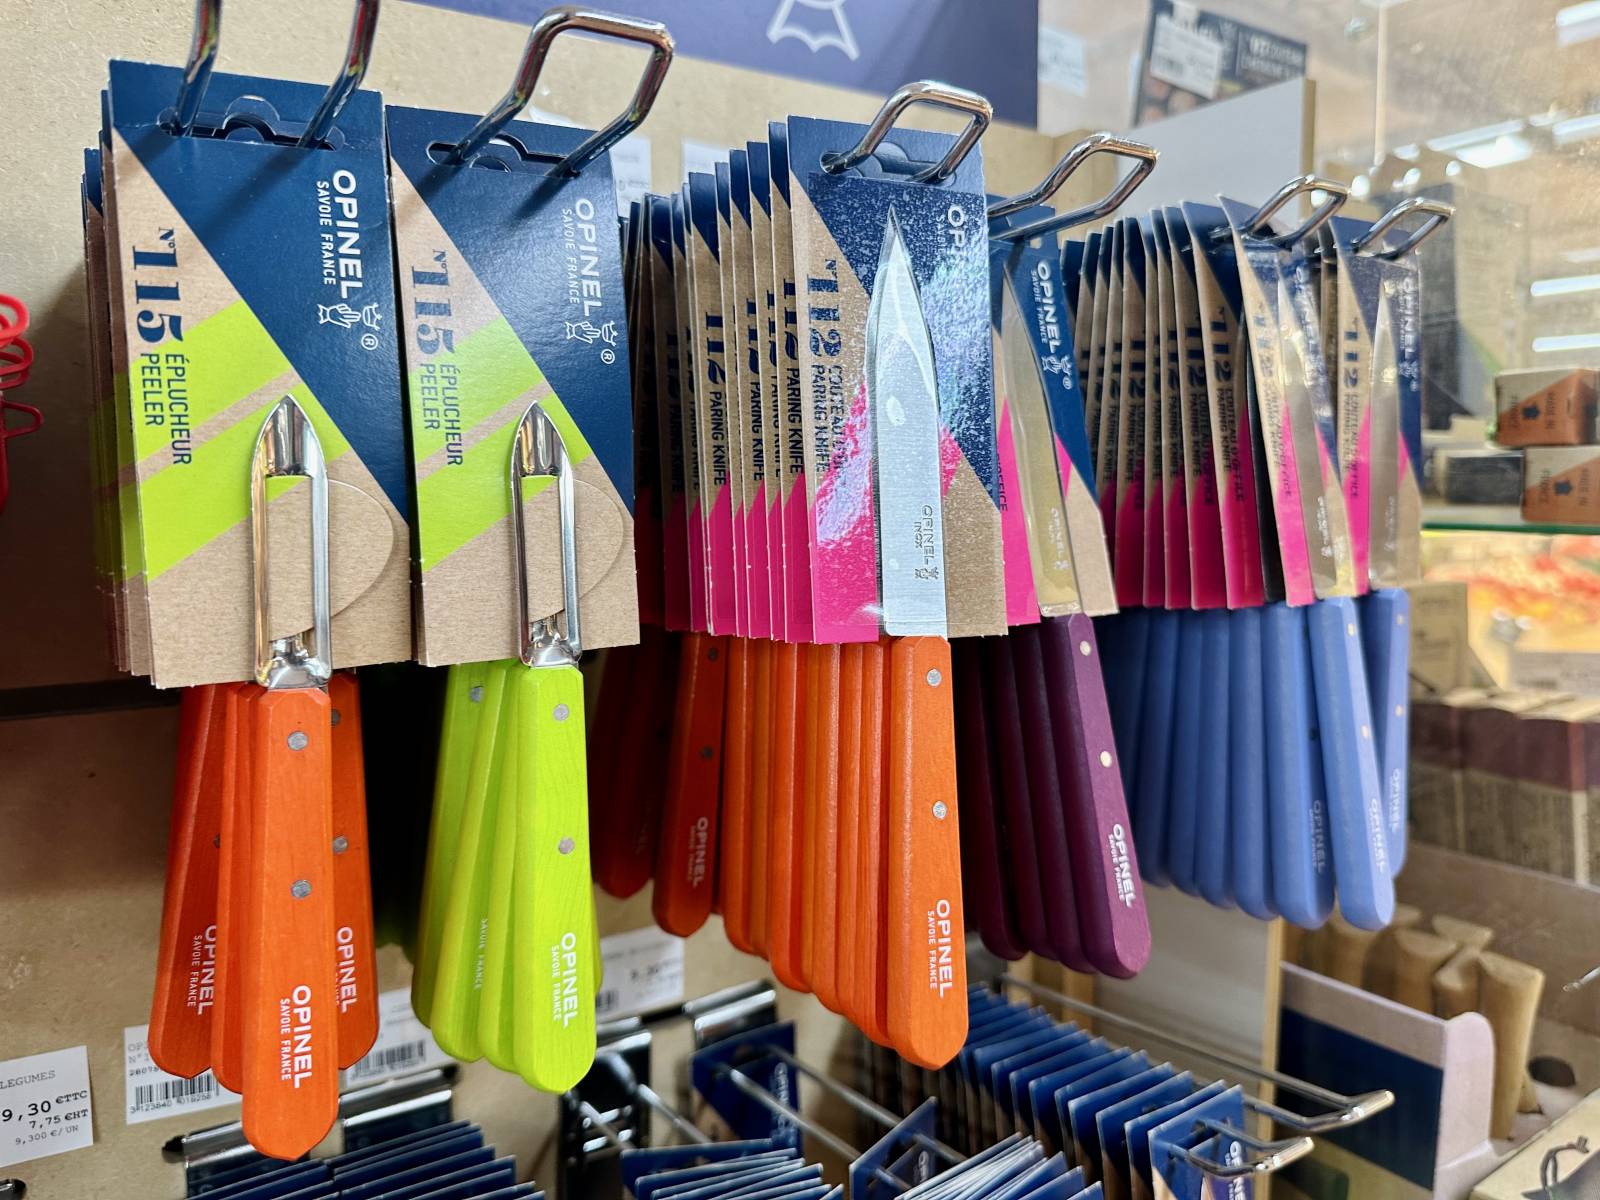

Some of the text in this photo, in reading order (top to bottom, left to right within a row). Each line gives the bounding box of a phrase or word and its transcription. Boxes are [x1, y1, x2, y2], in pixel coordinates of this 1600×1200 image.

[317, 181, 336, 285] SAVOIE FRANCE
[332, 169, 363, 299] OPINEL
[562, 208, 580, 304] SAVOIE FRANCE
[575, 198, 602, 317] OPINEL
[1037, 260, 1062, 354] OPINEL
[140, 353, 165, 426] PEELER
[165, 353, 192, 465] ÉPLUCHEUR
[419, 362, 441, 430] PEELER
[440, 362, 464, 466] ÉPLUCHEUR
[750, 382, 765, 481] PARING KNIFE
[786, 367, 804, 475] PARING KNIFE
[812, 364, 831, 474] PARING KNIFE
[1215, 388, 1232, 474] PARING KNIFE
[1224, 388, 1238, 448] COUTEAU
[709, 391, 728, 486] PARING KNIFE
[913, 520, 923, 549] INOX
[923, 503, 936, 568] OPINEL
[693, 817, 709, 889] OPINEL
[1113, 823, 1137, 908] OPINEL
[187, 935, 203, 1008] SAVOIE FRANCE
[336, 926, 358, 1014] OPINEL
[551, 945, 562, 1022] SAVOIE FRANCE
[560, 931, 578, 1029] OPINEL
[927, 910, 938, 990] SAVOIE FRANCE
[936, 899, 953, 998] OPINEL
[0, 1070, 56, 1089] LEGUMES
[280, 998, 292, 1081] SAVOIE FRANCE
[292, 984, 313, 1089] OPINEL
[1, 1100, 52, 1122] 9,30
[15, 1131, 47, 1145] 9,300
[29, 1115, 62, 1129] 7,75
